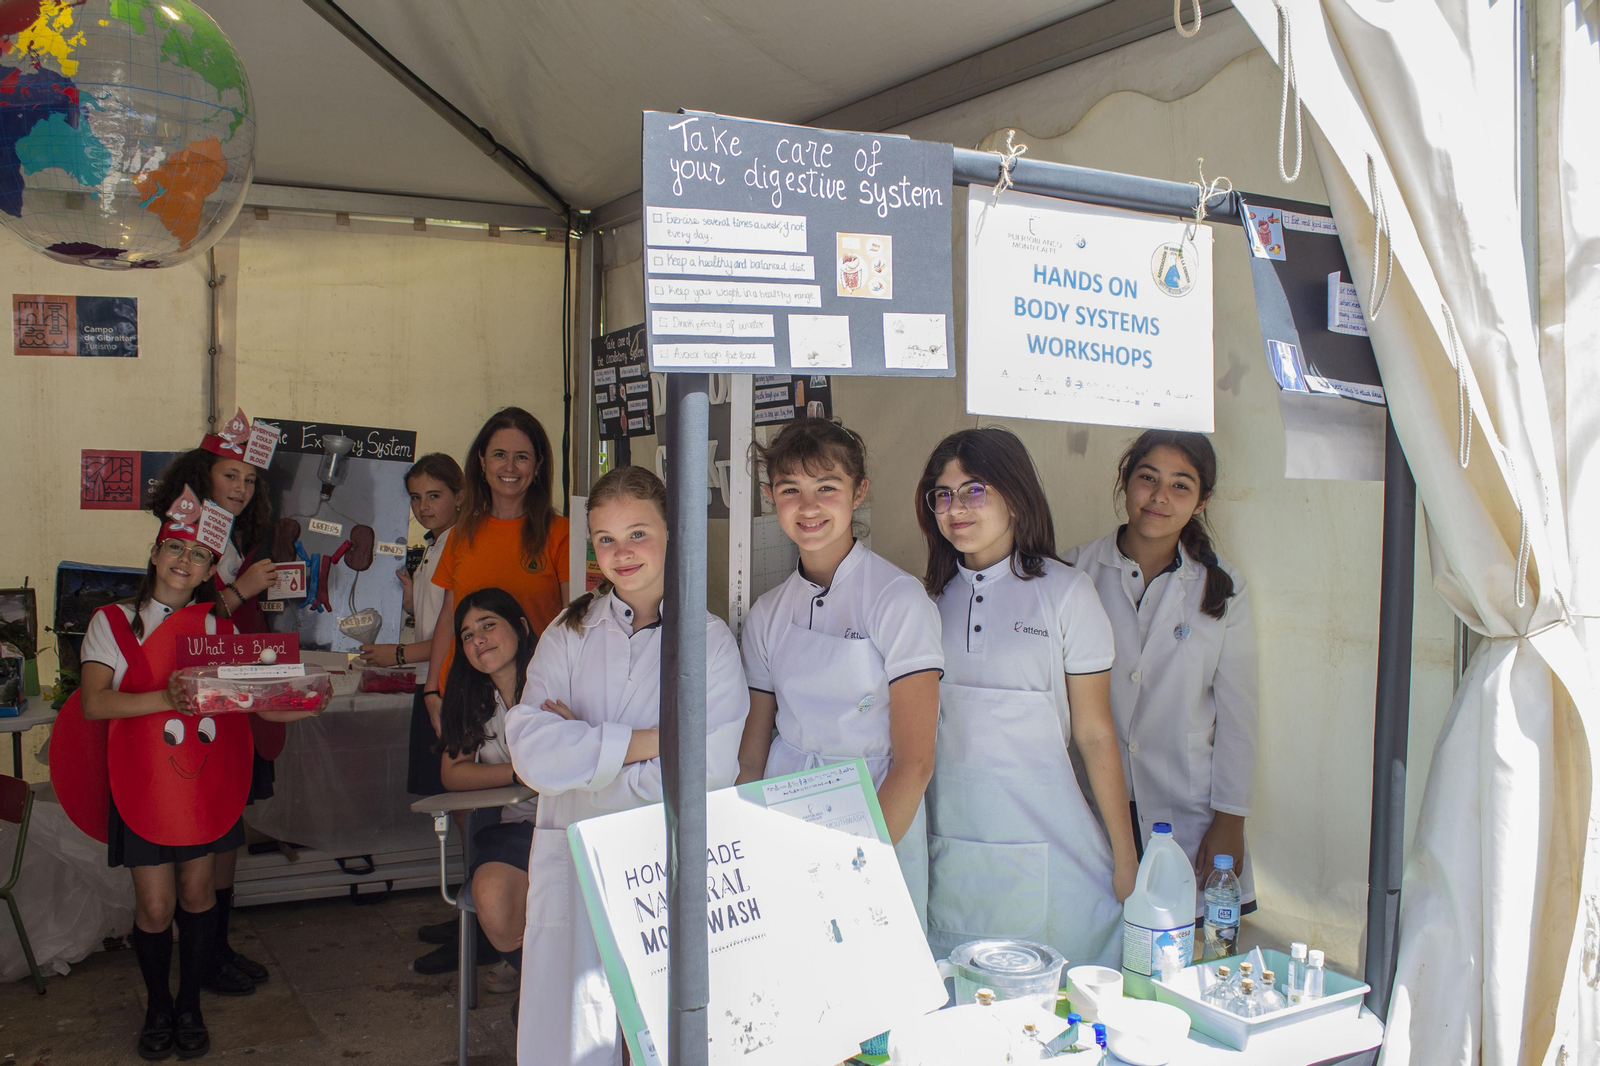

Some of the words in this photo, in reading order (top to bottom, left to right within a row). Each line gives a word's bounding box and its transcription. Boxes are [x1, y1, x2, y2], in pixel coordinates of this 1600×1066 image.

[668, 117, 742, 157] Take
[776, 138, 833, 168] care
[854, 139, 883, 177] of
[669, 156, 726, 196] your
[744, 157, 847, 208] digestive
[858, 174, 943, 218] system
[666, 212, 700, 225] Exercise
[702, 217, 731, 227] several
[733, 217, 753, 229] times
[790, 221, 805, 231] not
[667, 229, 691, 244] every
[693, 229, 713, 244] day.
[667, 253, 688, 272] Keep
[690, 258, 697, 267] a
[699, 255, 733, 276] healthy
[733, 258, 747, 269] and
[1033, 263, 1103, 293] HANDS
[1108, 276, 1138, 300] ON
[668, 285, 690, 300] Keep
[1014, 296, 1070, 323] BODY
[1075, 305, 1160, 337] SYSTEMS
[84, 326, 114, 335] Campo
[725, 319, 735, 335] of
[84, 334, 95, 342] de
[97, 334, 132, 342] Gibraltar
[1026, 333, 1153, 370] WORKSHOPS
[252, 425, 279, 440] EVERYONE
[255, 434, 273, 445] COULD
[250, 440, 259, 448] BE
[367, 430, 412, 458] System
[249, 447, 270, 460] DONATE
[249, 455, 267, 466] BLOOD
[202, 505, 233, 524] EVERYONE
[208, 514, 226, 528] COULD
[203, 520, 212, 528] BE
[312, 522, 339, 534] URETERS
[202, 527, 225, 543] DONATE
[203, 535, 222, 549] BLOOD
[188, 637, 225, 655] What
[233, 643, 244, 655] is
[252, 639, 287, 655] Blood
[633, 868, 750, 923] NARAL
[641, 897, 761, 955] MOWASH
